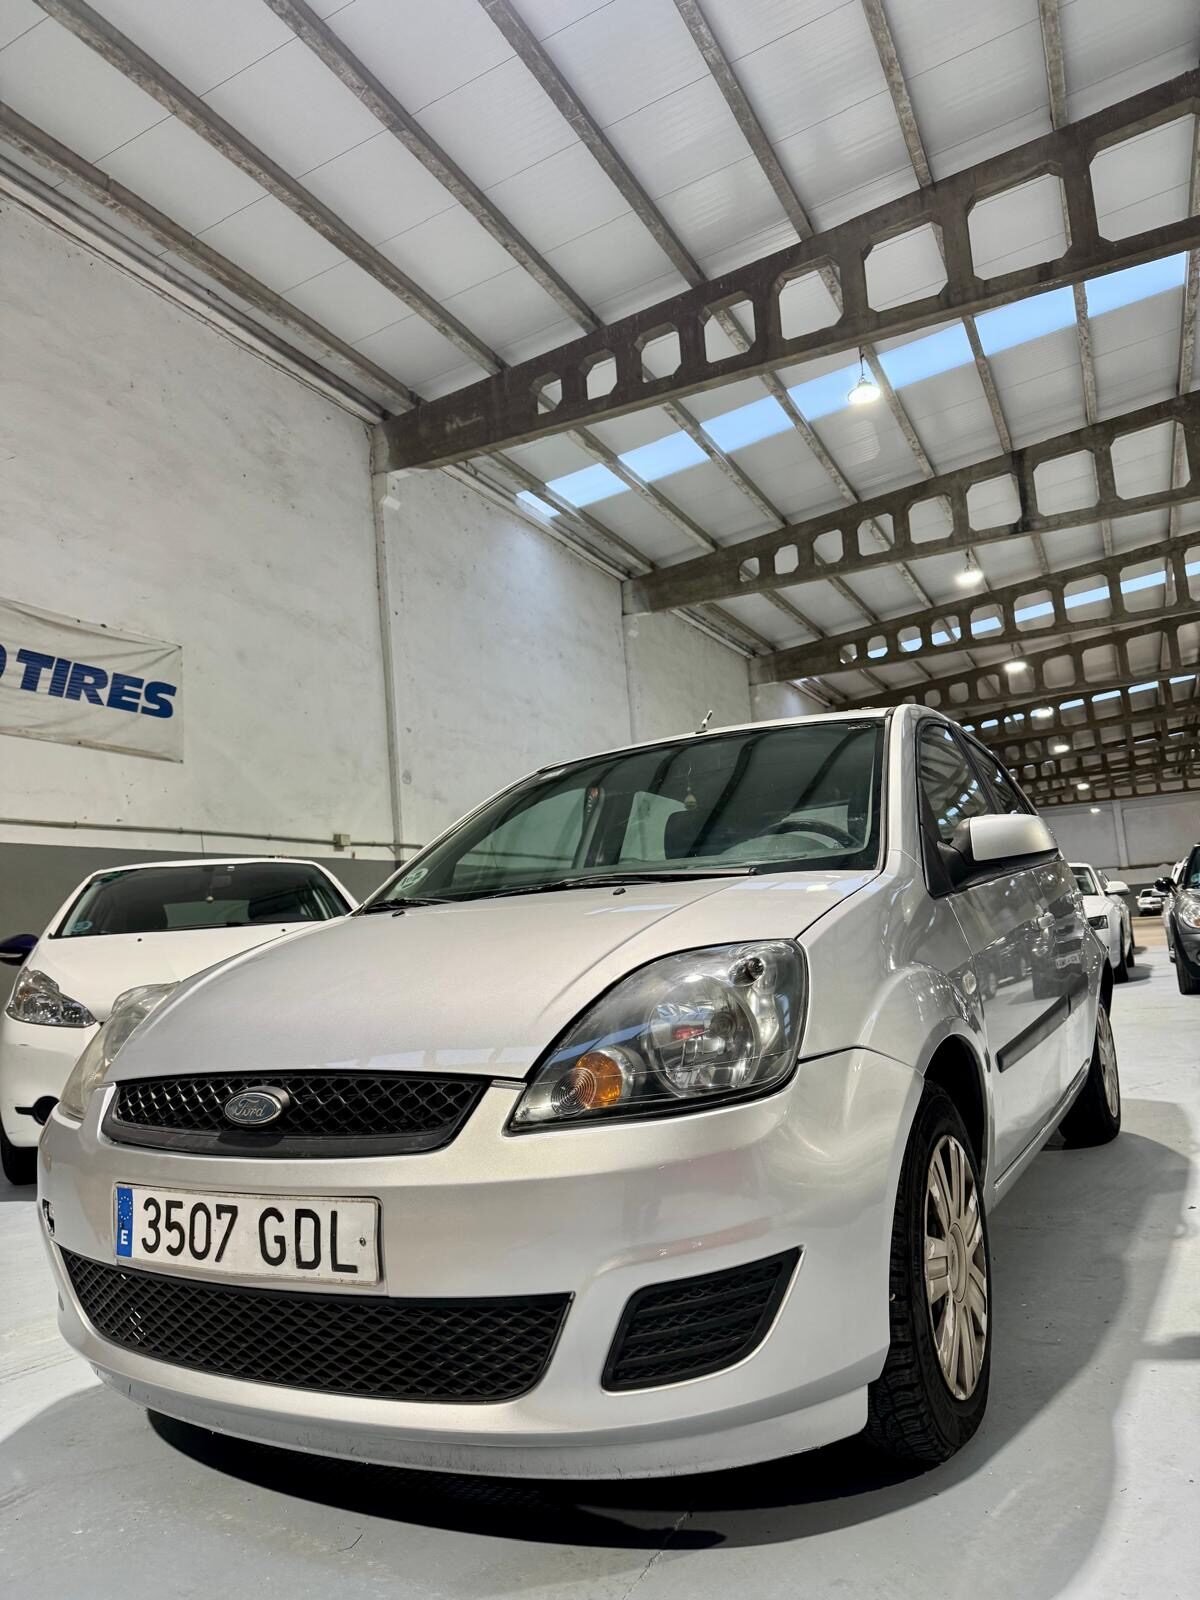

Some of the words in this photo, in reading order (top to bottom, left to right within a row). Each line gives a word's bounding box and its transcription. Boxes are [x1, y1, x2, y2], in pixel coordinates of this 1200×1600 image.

[16, 648, 177, 719] TIRES
[235, 1098, 266, 1117] Ford
[120, 1229, 129, 1245] E
[141, 1197, 238, 1263] 3507
[258, 1206, 358, 1274] GDL
